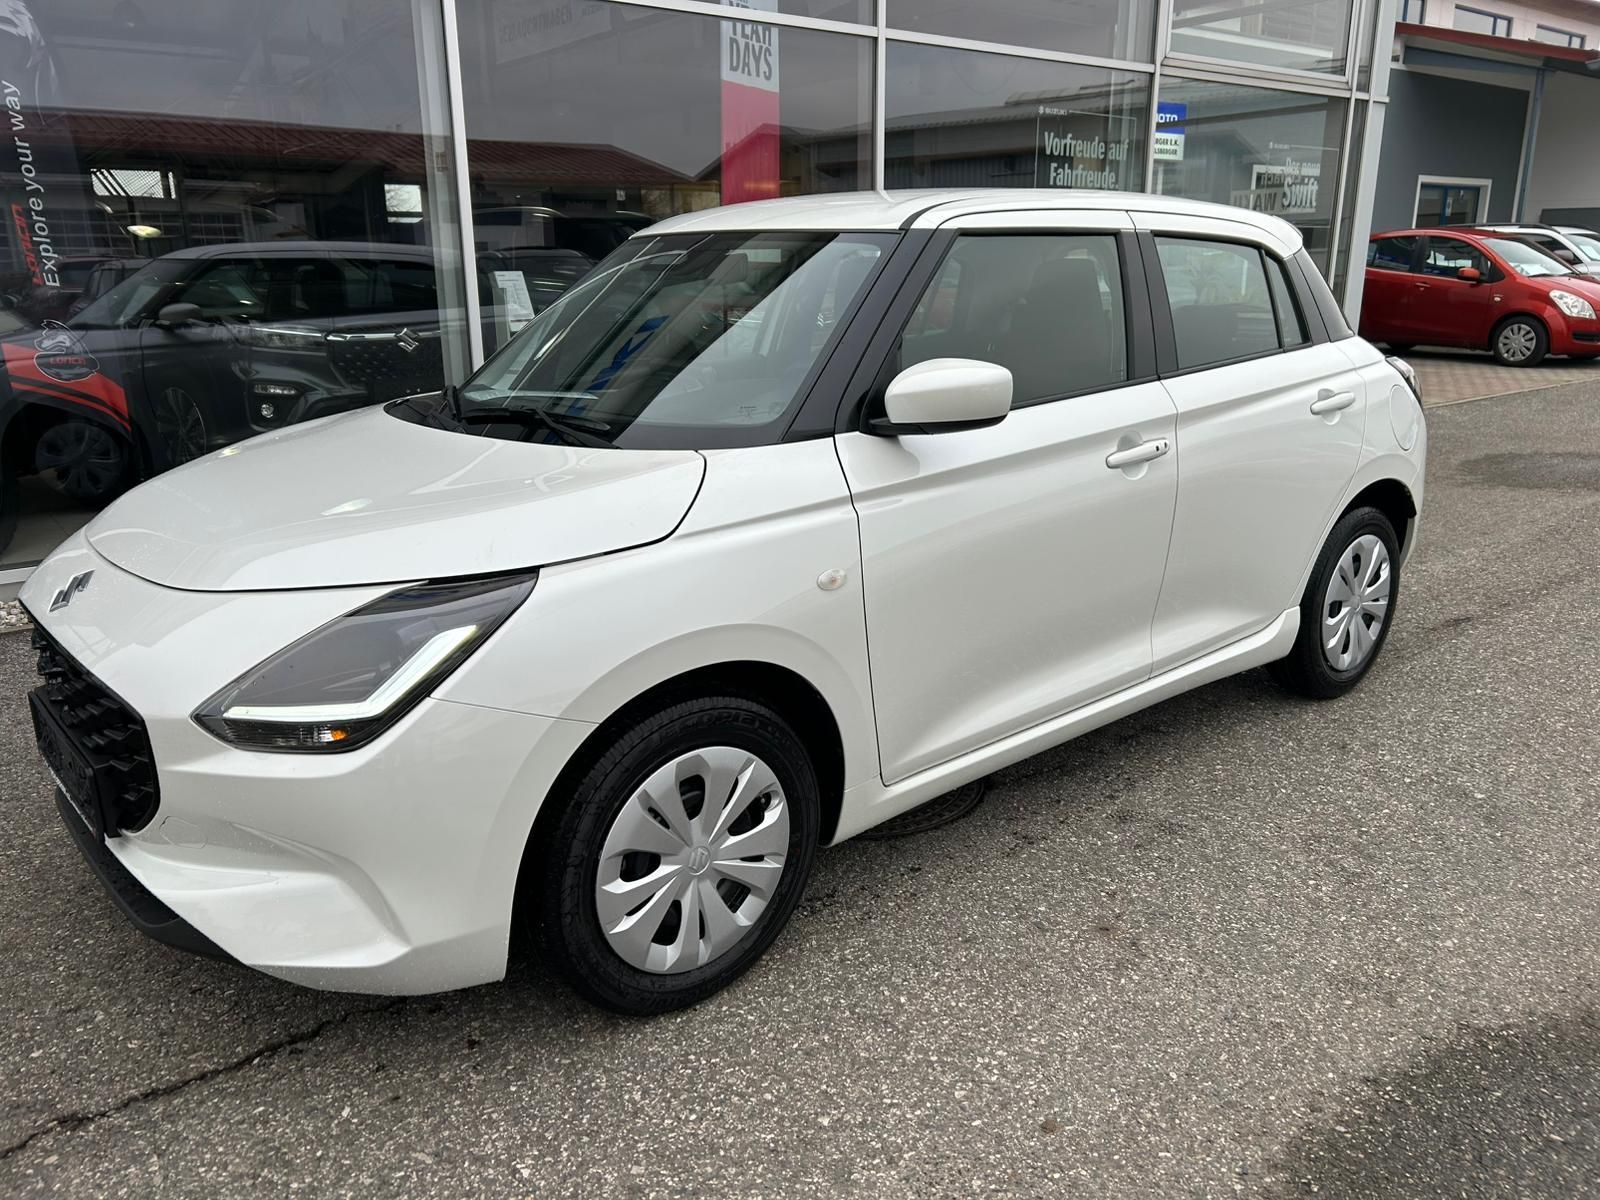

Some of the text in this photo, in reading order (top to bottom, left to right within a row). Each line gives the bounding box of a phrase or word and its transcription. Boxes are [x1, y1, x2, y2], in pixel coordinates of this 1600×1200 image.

[729, 36, 772, 81] DAYS
[1044, 131, 1129, 161] Vorfreude auf
[2, 80, 60, 287] Explore your way
[1049, 162, 1120, 190] Fahrfreude.
[1283, 176, 1318, 209] Swift
